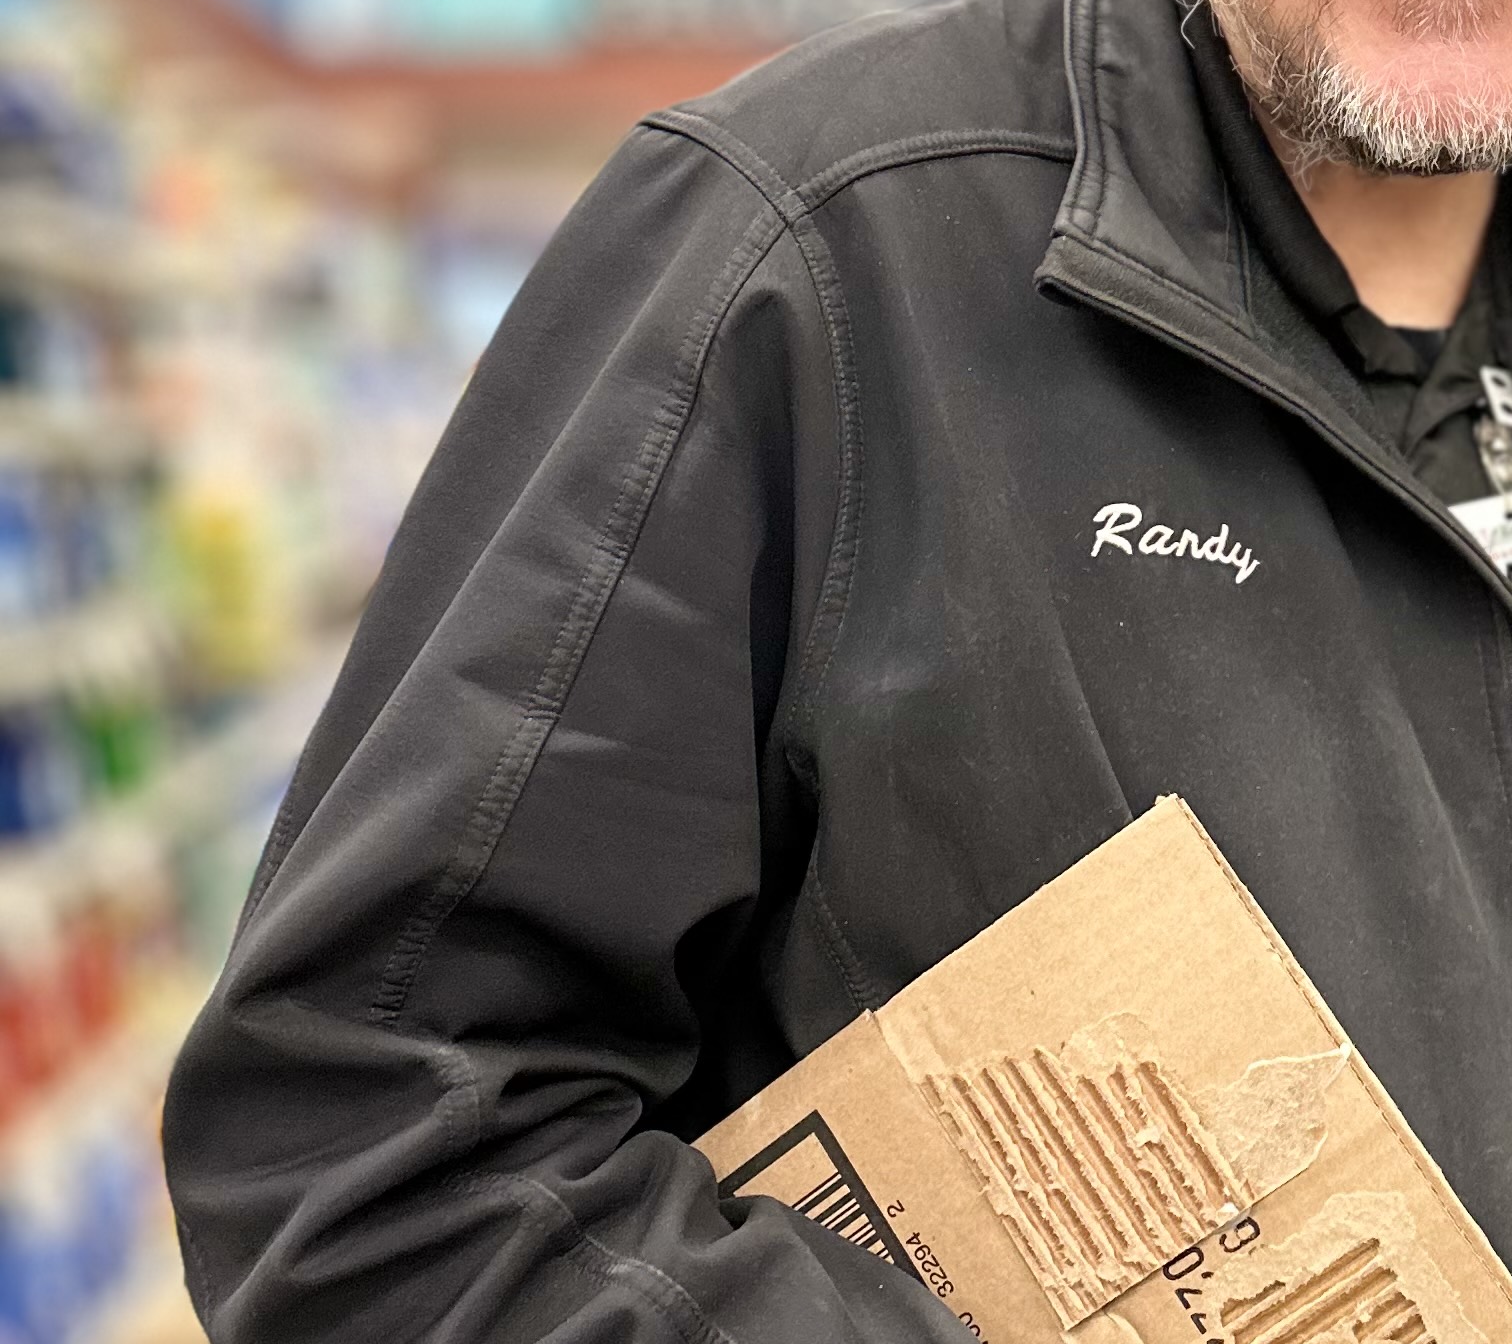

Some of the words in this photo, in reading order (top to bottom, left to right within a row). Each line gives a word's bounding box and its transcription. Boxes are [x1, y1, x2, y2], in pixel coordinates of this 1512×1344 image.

[1090, 502, 1261, 584] Randy
[887, 1199, 905, 1219] 2
[907, 1231, 954, 1298] 32294
